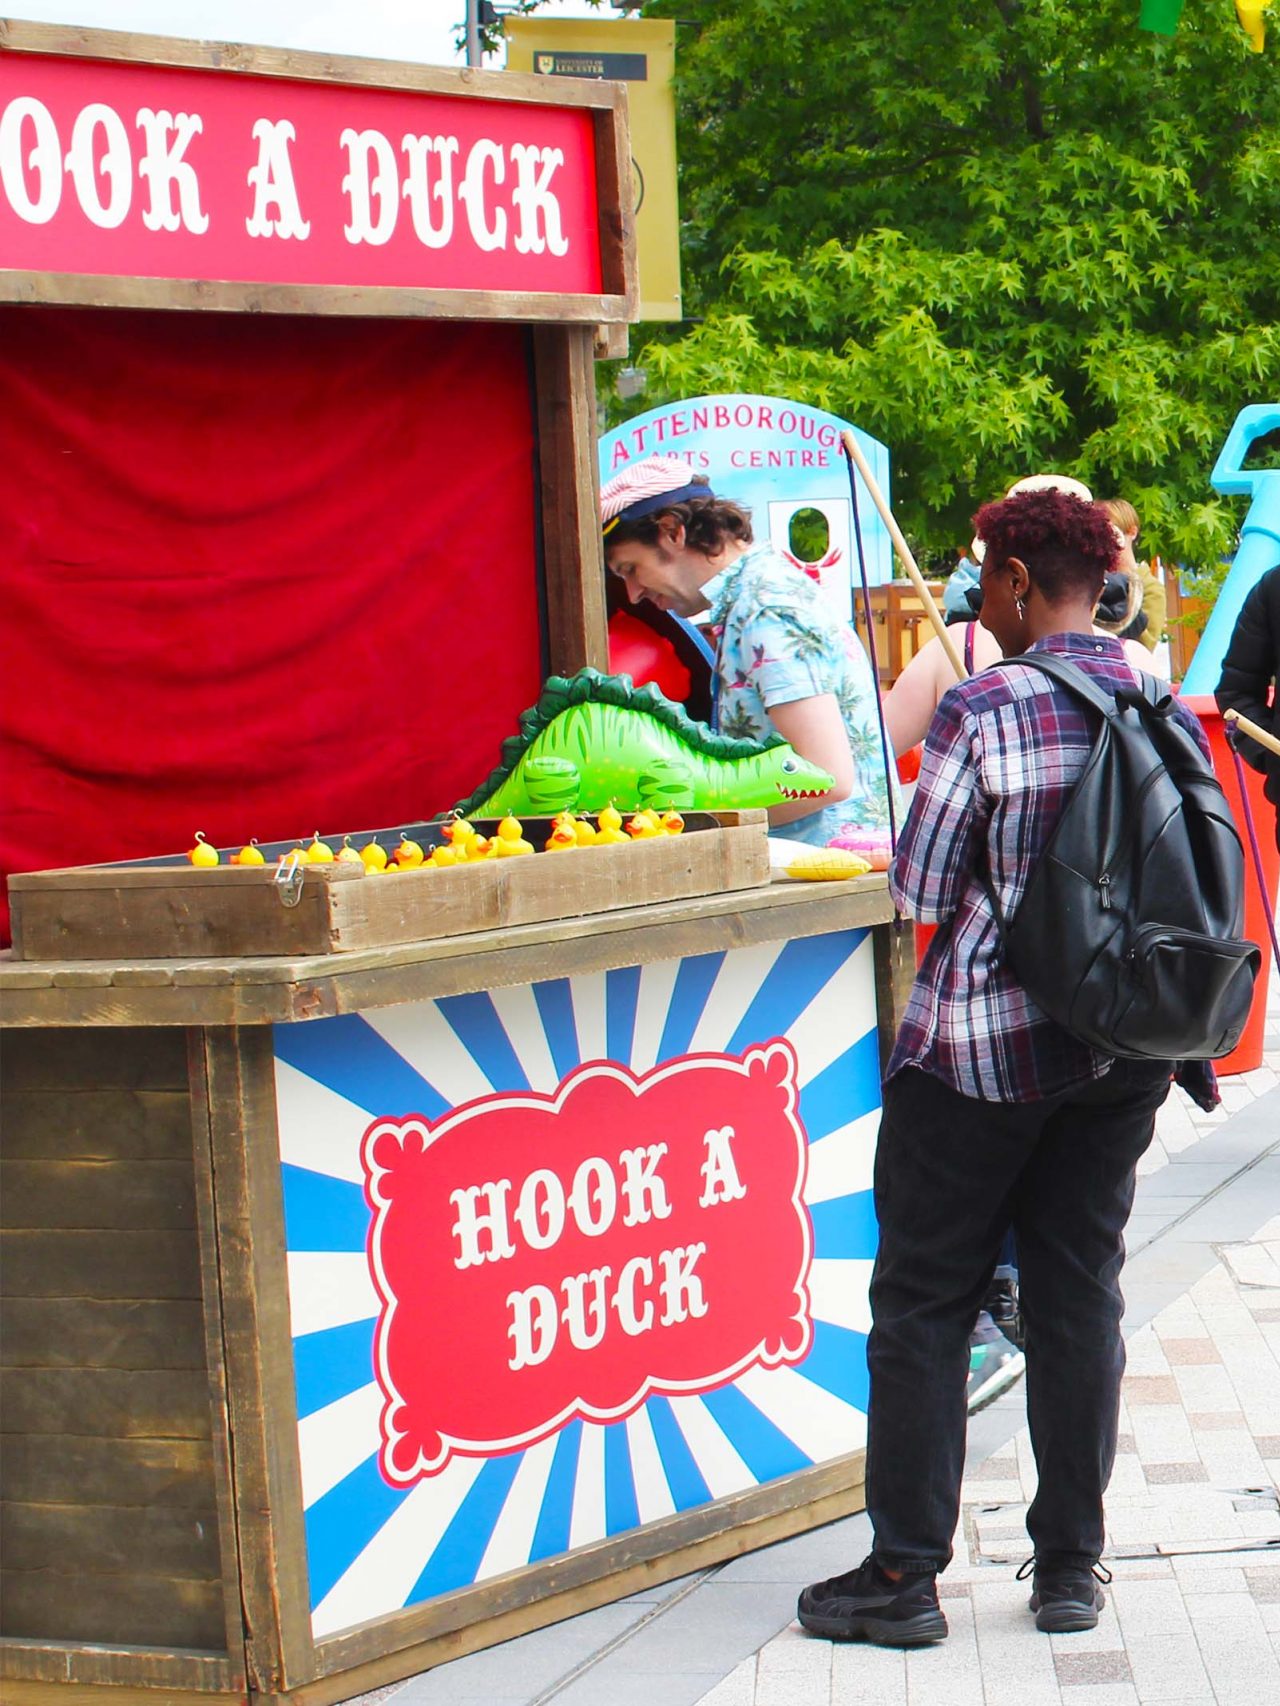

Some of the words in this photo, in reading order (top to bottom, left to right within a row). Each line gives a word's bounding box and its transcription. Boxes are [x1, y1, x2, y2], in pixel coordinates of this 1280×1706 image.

[556, 65, 604, 73] LEICESTER
[0, 96, 209, 235] OOK
[245, 118, 311, 240] A
[340, 128, 569, 256] DUCK
[730, 450, 830, 468] CENTRE
[450, 1143, 672, 1269] HOOK
[699, 1126, 747, 1208] A
[506, 1242, 708, 1370] DUCK
